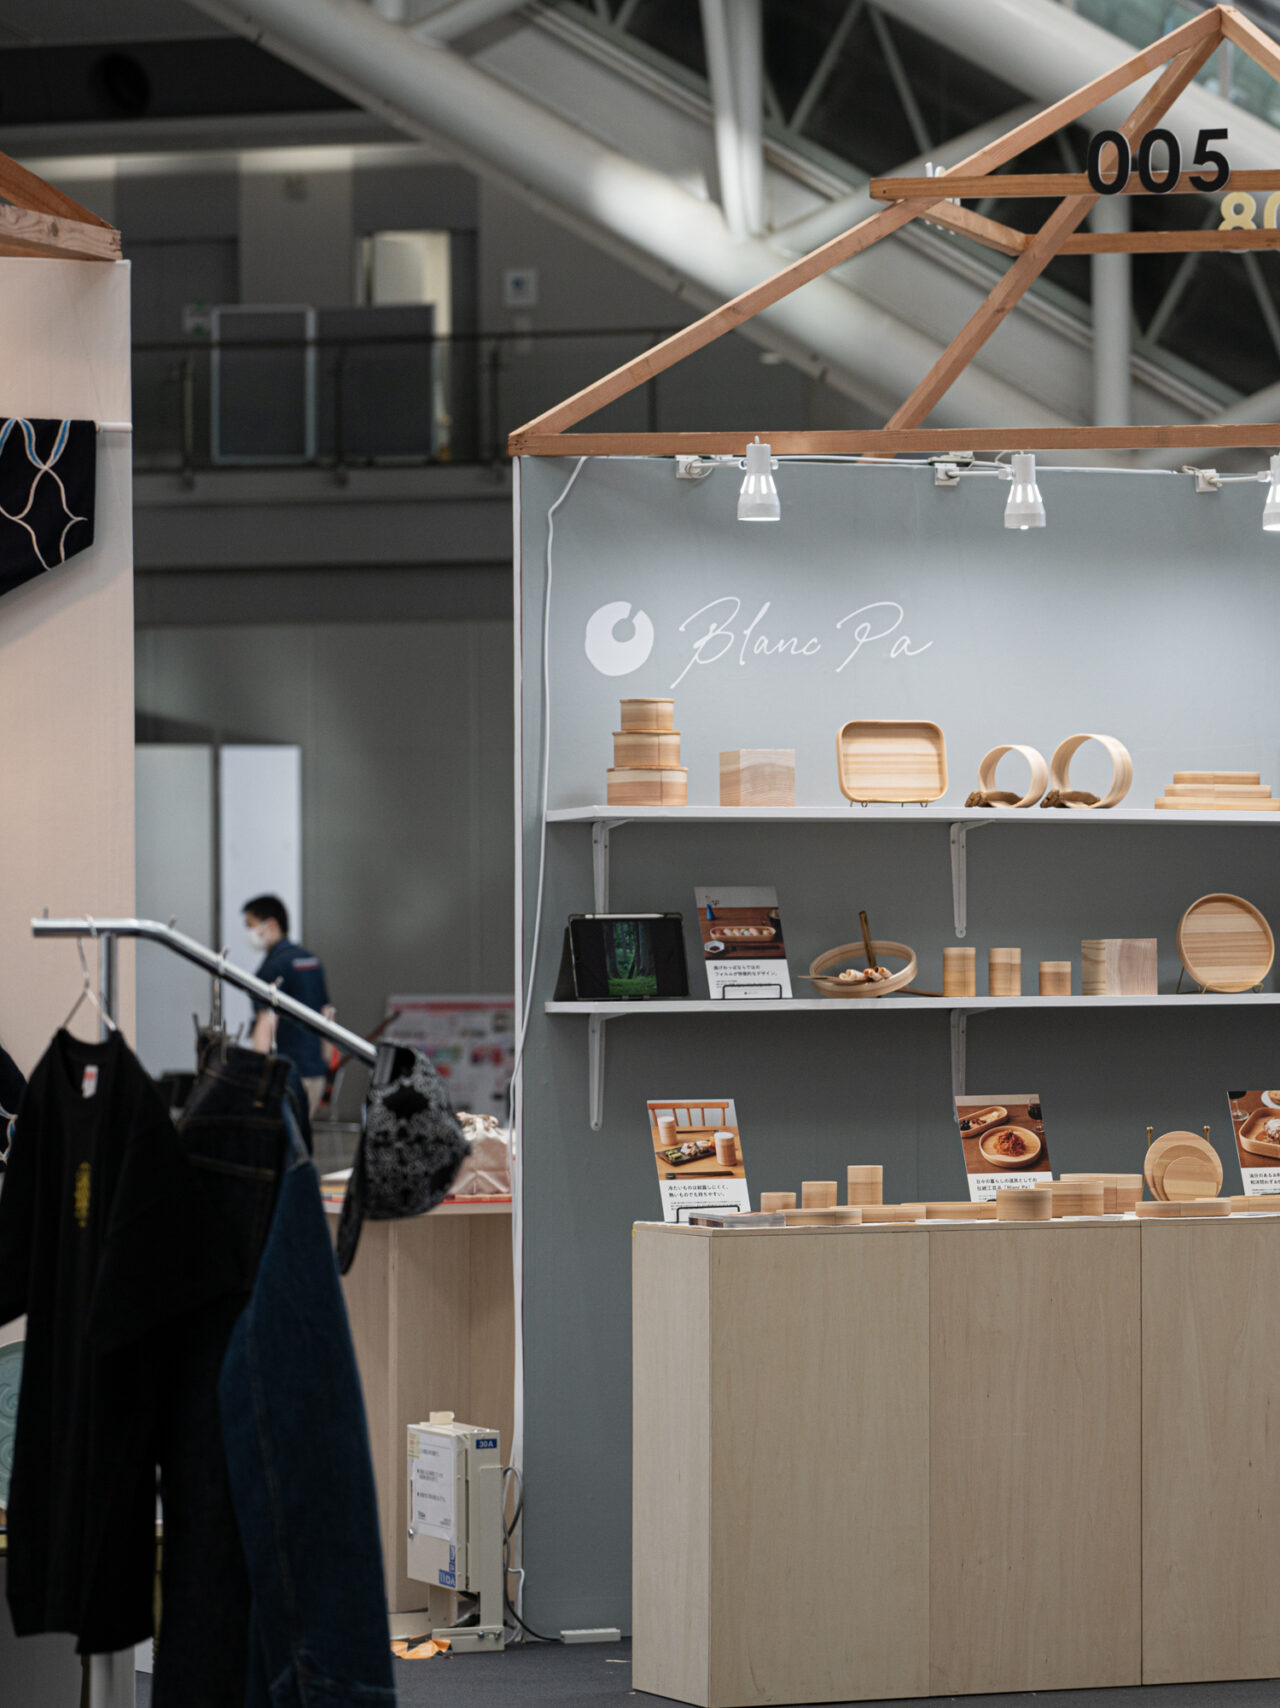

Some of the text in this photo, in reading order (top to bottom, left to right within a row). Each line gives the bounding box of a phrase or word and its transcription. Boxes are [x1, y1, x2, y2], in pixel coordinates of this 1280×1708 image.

[1087, 128, 1231, 195] 005
[670, 596, 933, 689] Blanc Pa
[479, 1440, 494, 1448] 30A
